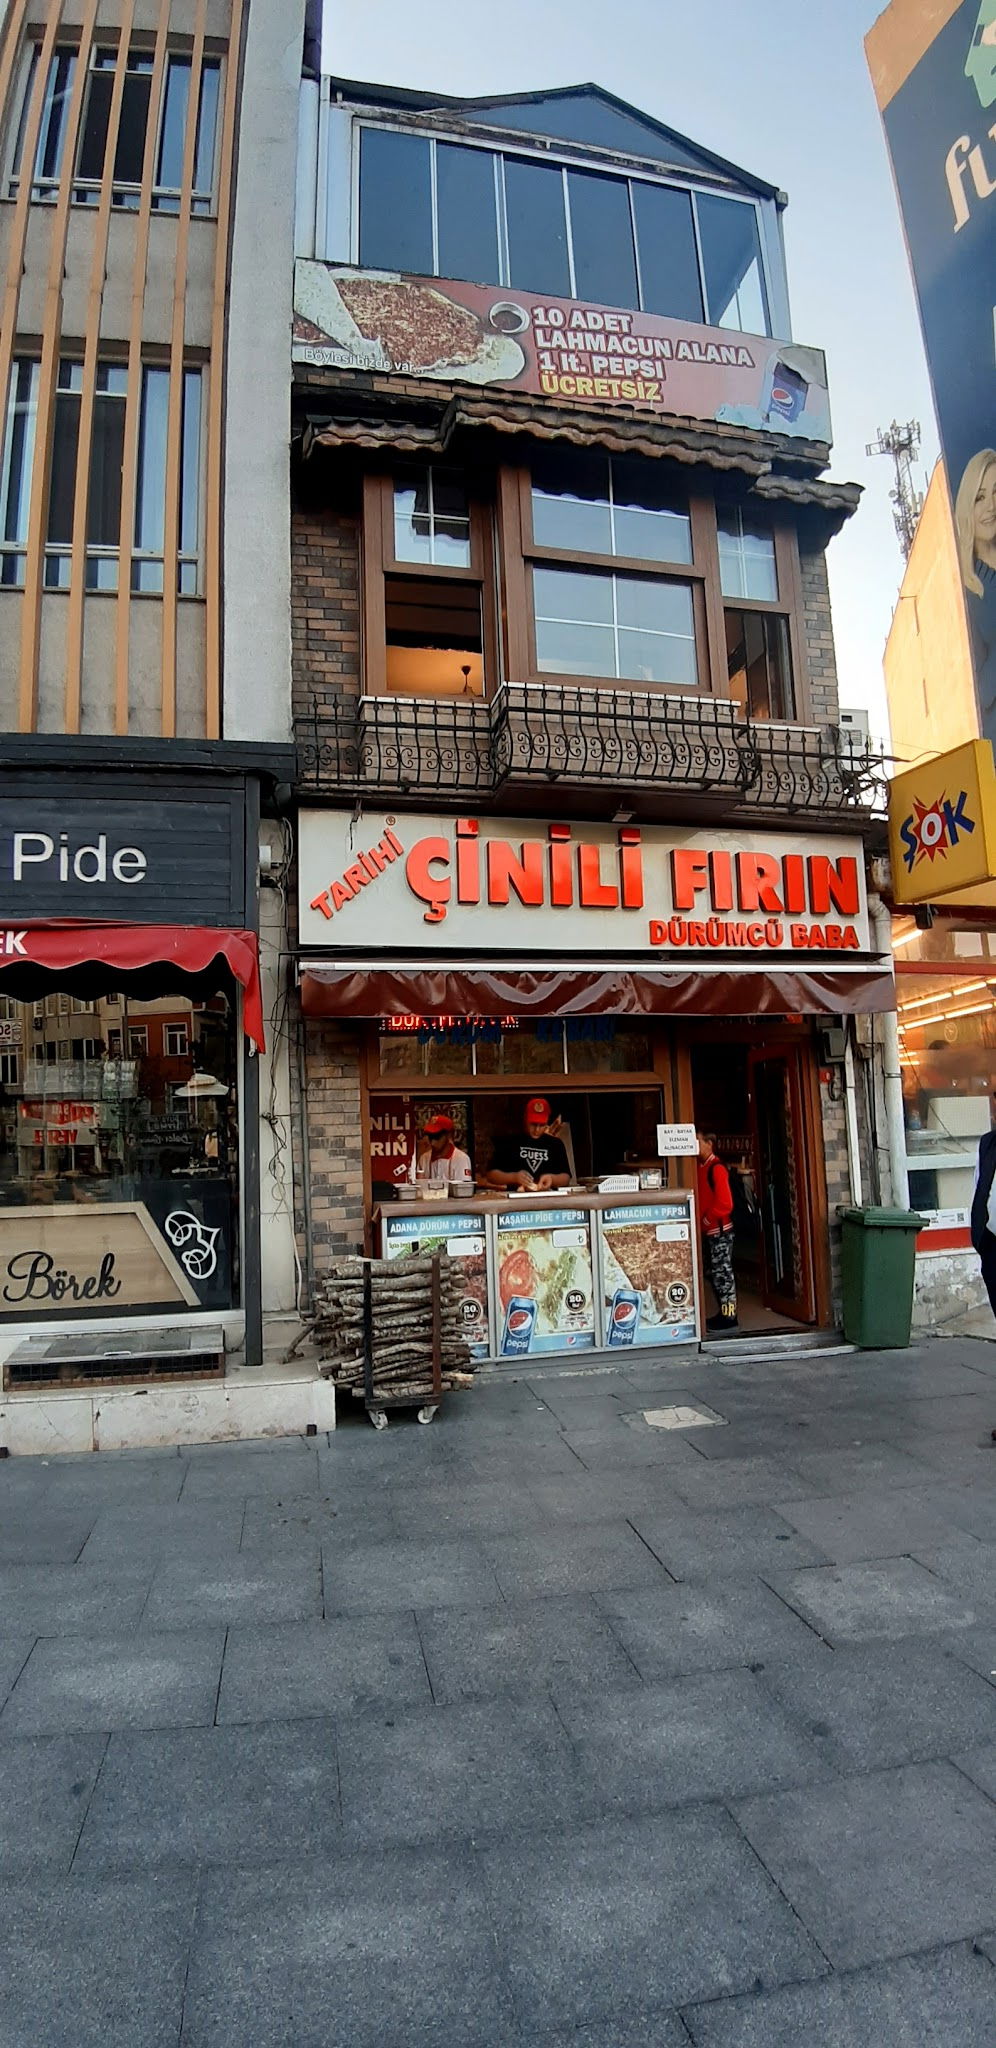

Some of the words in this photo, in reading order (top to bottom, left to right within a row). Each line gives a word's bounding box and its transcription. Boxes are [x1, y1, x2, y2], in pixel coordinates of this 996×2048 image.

[533, 307, 564, 327] 10
[570, 312, 632, 333] ADET
[304, 349, 354, 365] Böylesi
[357, 354, 391, 369] bizde
[535, 329, 672, 359] LAHMACUN
[677, 341, 754, 367] ALANA
[539, 352, 556, 371] 1
[592, 356, 665, 379] PEPSI
[541, 371, 662, 400] ÜCRETSİZ
[900, 789, 976, 874] ŞOK
[13, 831, 148, 883] Pide
[310, 827, 404, 920] TARİHİ
[406, 818, 644, 923] ÇİNİLİ
[670, 849, 860, 915] FIRIN
[0, 930, 28, 955] K
[649, 916, 785, 947] DÜRÜMCÜ
[790, 923, 860, 949] BABA
[519, 1149, 549, 1161] GUESS
[499, 1214, 533, 1226] KAŞARLI
[604, 1208, 652, 1220] LAHMACUN
[389, 1221, 419, 1234] ADANA
[3, 1250, 122, 1302] Börek
[506, 1339, 528, 1349] pepsi
[612, 1330, 633, 1340] pepsi
